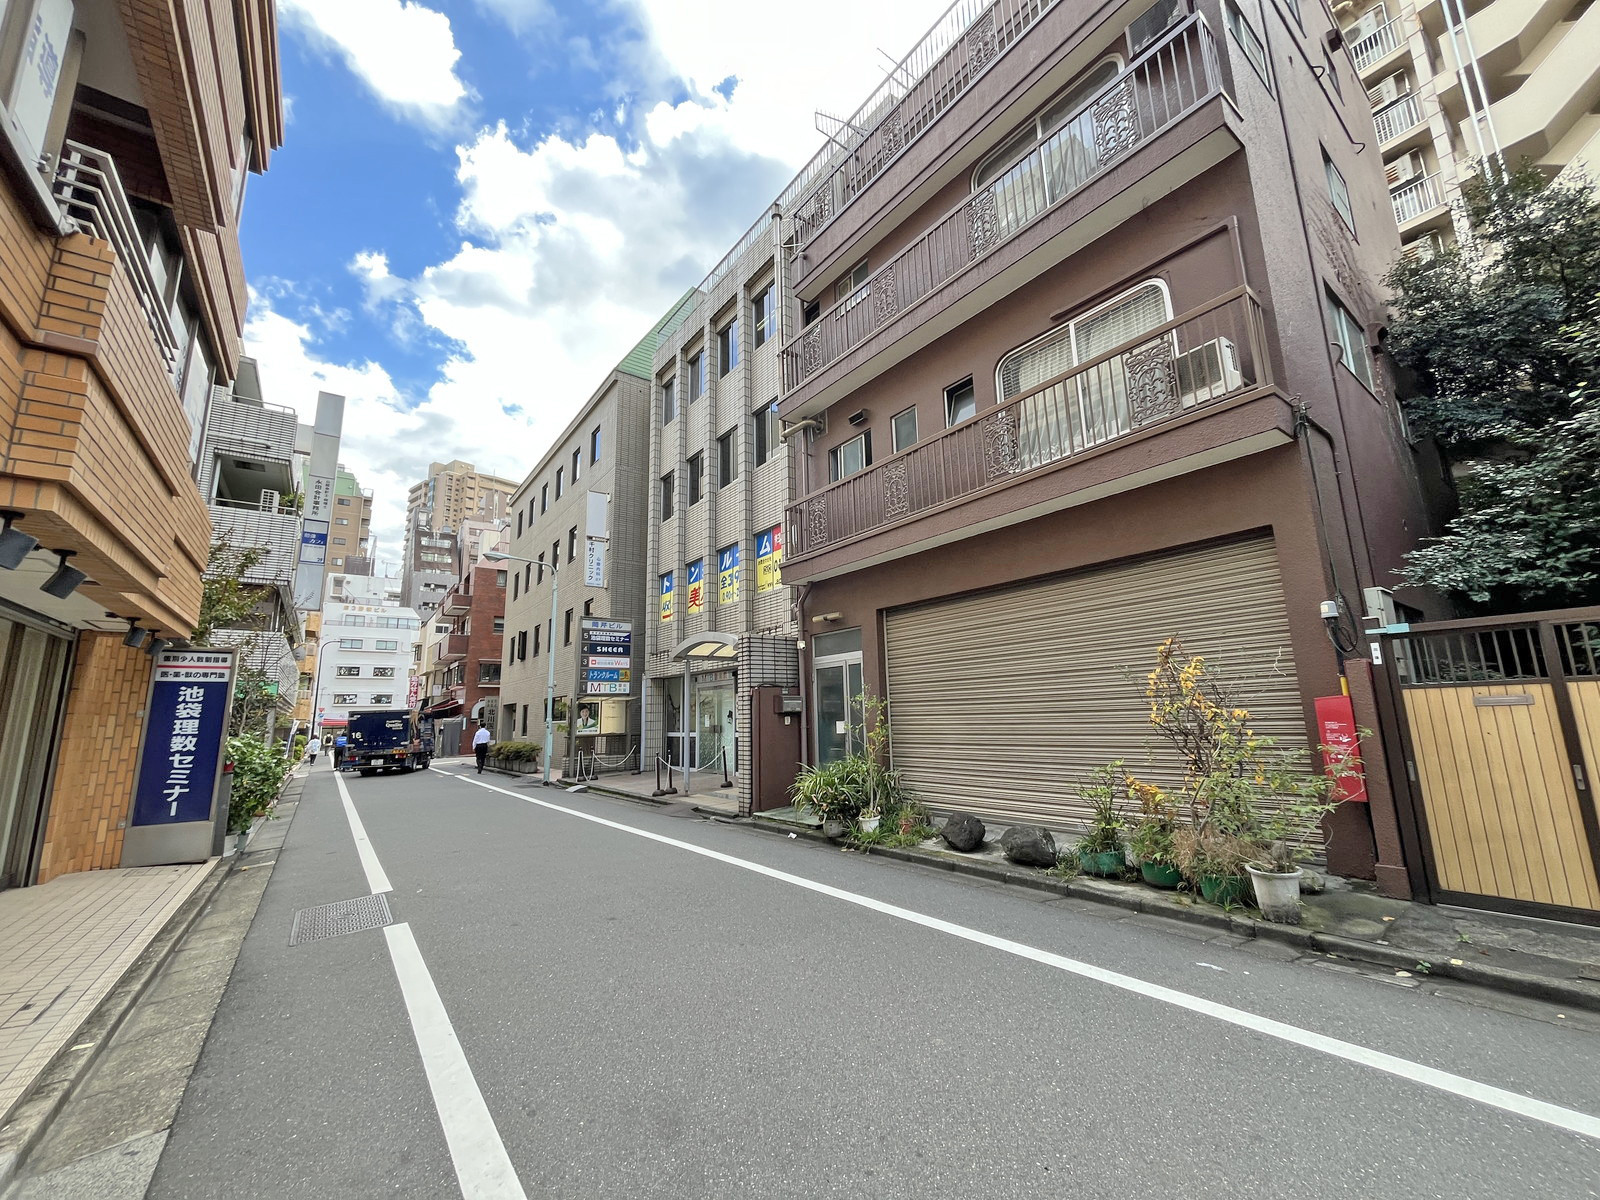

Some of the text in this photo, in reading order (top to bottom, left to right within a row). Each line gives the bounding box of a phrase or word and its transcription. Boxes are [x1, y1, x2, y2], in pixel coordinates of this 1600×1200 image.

[589, 671, 618, 679] トランクルーム
[590, 683, 617, 692] MTB
[163, 685, 205, 817] 池袋理数セミナー
